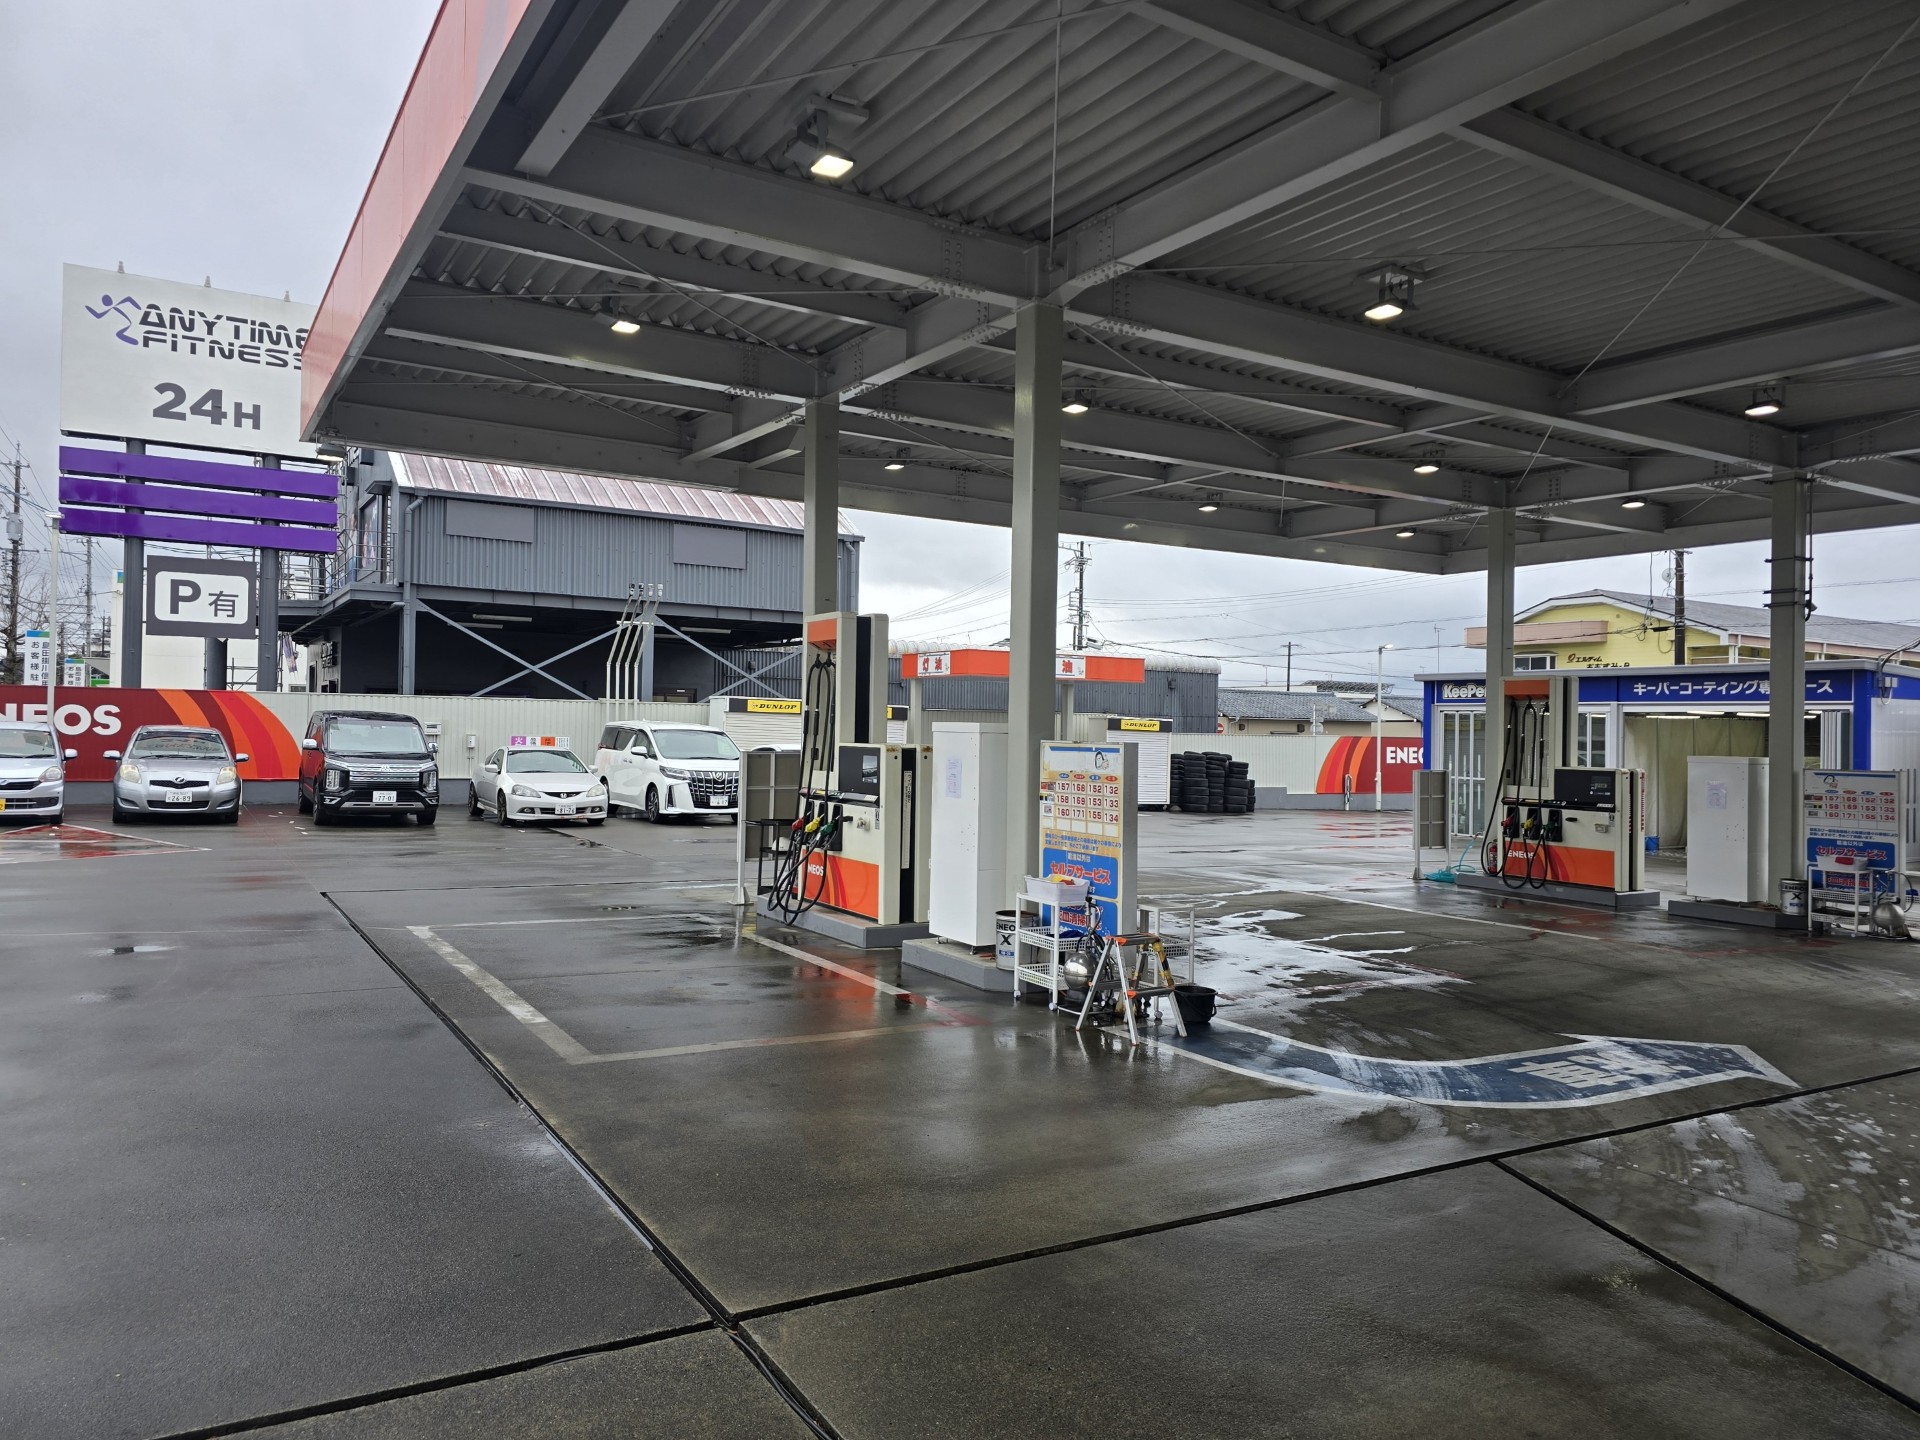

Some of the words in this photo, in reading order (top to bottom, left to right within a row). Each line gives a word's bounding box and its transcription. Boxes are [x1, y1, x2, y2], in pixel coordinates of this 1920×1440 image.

[139, 303, 309, 349] ANYTIME
[1443, 684, 1486, 698] KeePe
[1633, 679, 1833, 696] キーパーコーティング専ース
[1386, 746, 1424, 764] ENE
[1058, 783, 1070, 791] 157
[1073, 783, 1085, 792] 168
[1089, 784, 1102, 793] 152
[1105, 785, 1119, 794] 132
[1057, 795, 1069, 803] 158
[1073, 796, 1085, 805] 169
[1089, 797, 1102, 806] 153
[1105, 798, 1119, 808] 133
[1058, 808, 1070, 816] 160
[1073, 809, 1085, 818] 171
[1089, 811, 1102, 820] 155
[1105, 813, 1119, 822] 134
[1816, 846, 1887, 860] セルフサービス
[808, 864, 824, 876] NEOS
[1050, 861, 1111, 885] セルフサービス
[996, 922, 1016, 931] ENEO
[1000, 934, 1012, 946] X
